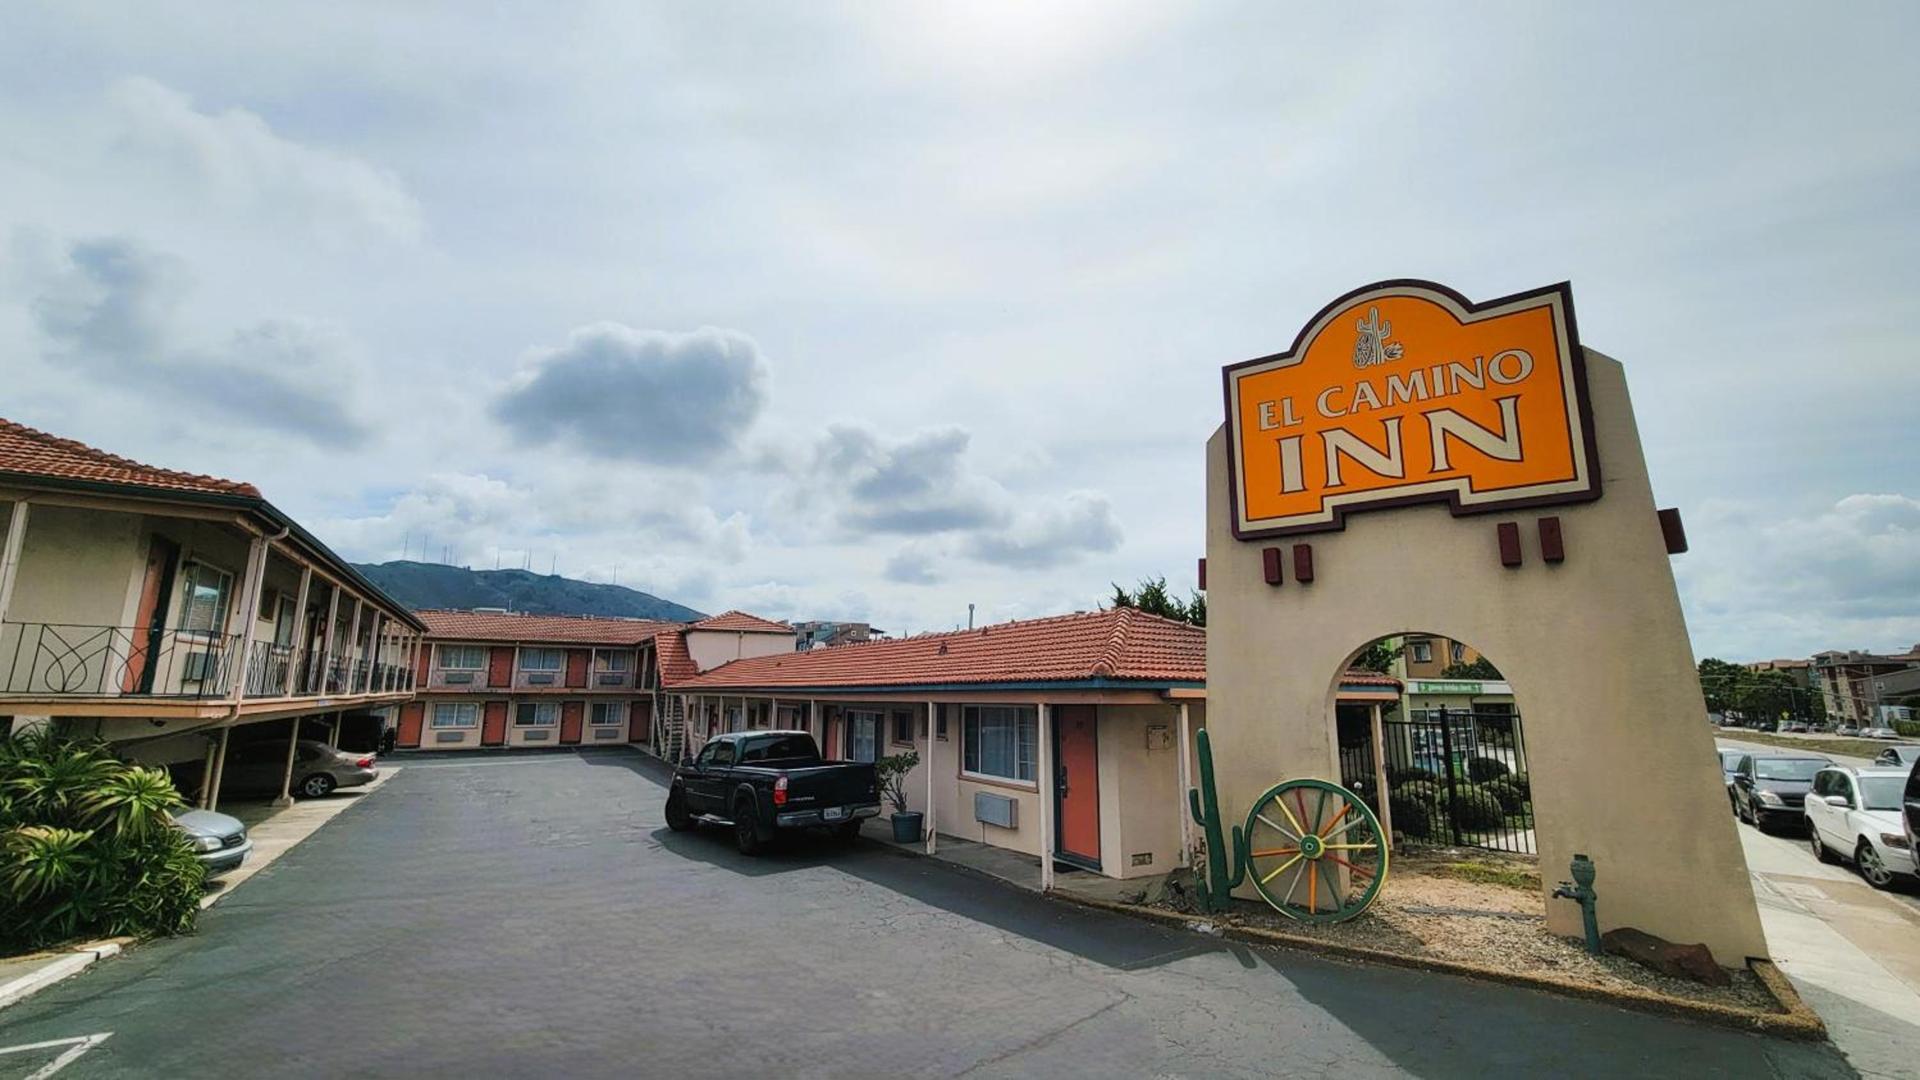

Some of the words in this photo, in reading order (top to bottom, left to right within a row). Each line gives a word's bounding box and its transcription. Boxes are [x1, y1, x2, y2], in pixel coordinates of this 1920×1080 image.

[1257, 396, 1304, 432] EL
[1316, 348, 1535, 419] CAMINO
[1275, 394, 1525, 495] INN
